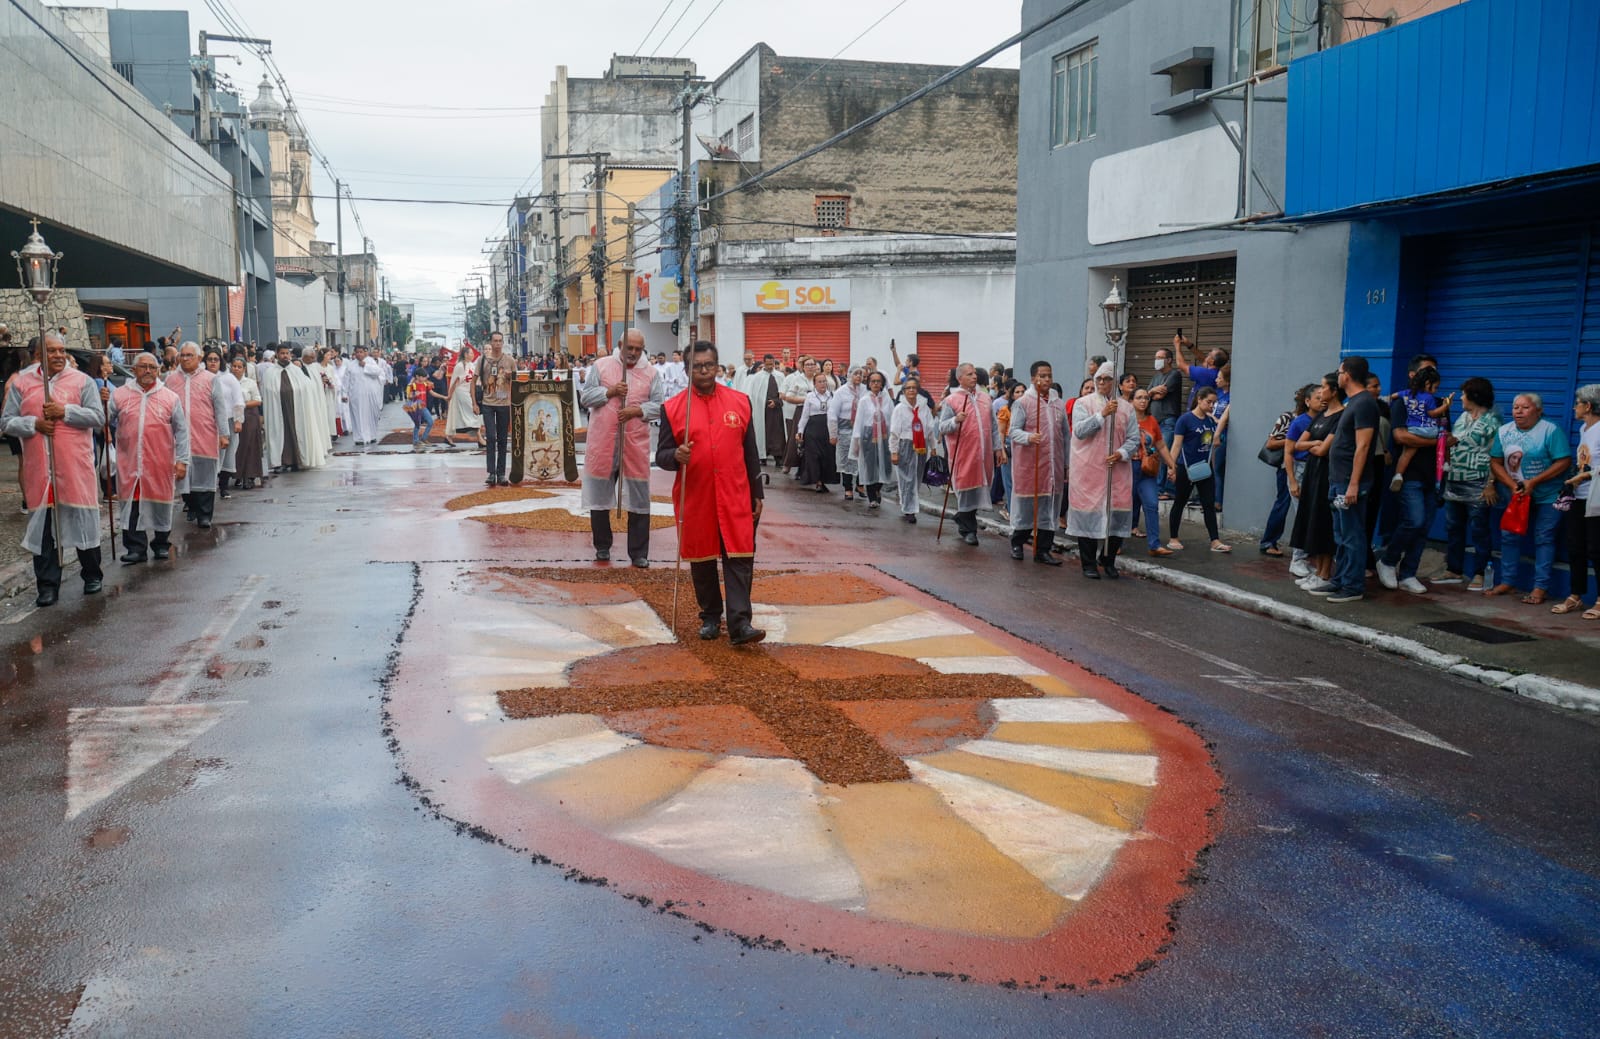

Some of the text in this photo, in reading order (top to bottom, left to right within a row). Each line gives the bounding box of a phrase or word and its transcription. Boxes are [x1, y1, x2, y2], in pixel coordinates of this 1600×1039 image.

[795, 286, 836, 305] SOL
[1366, 288, 1385, 305] 161
[658, 302, 680, 314] SO
